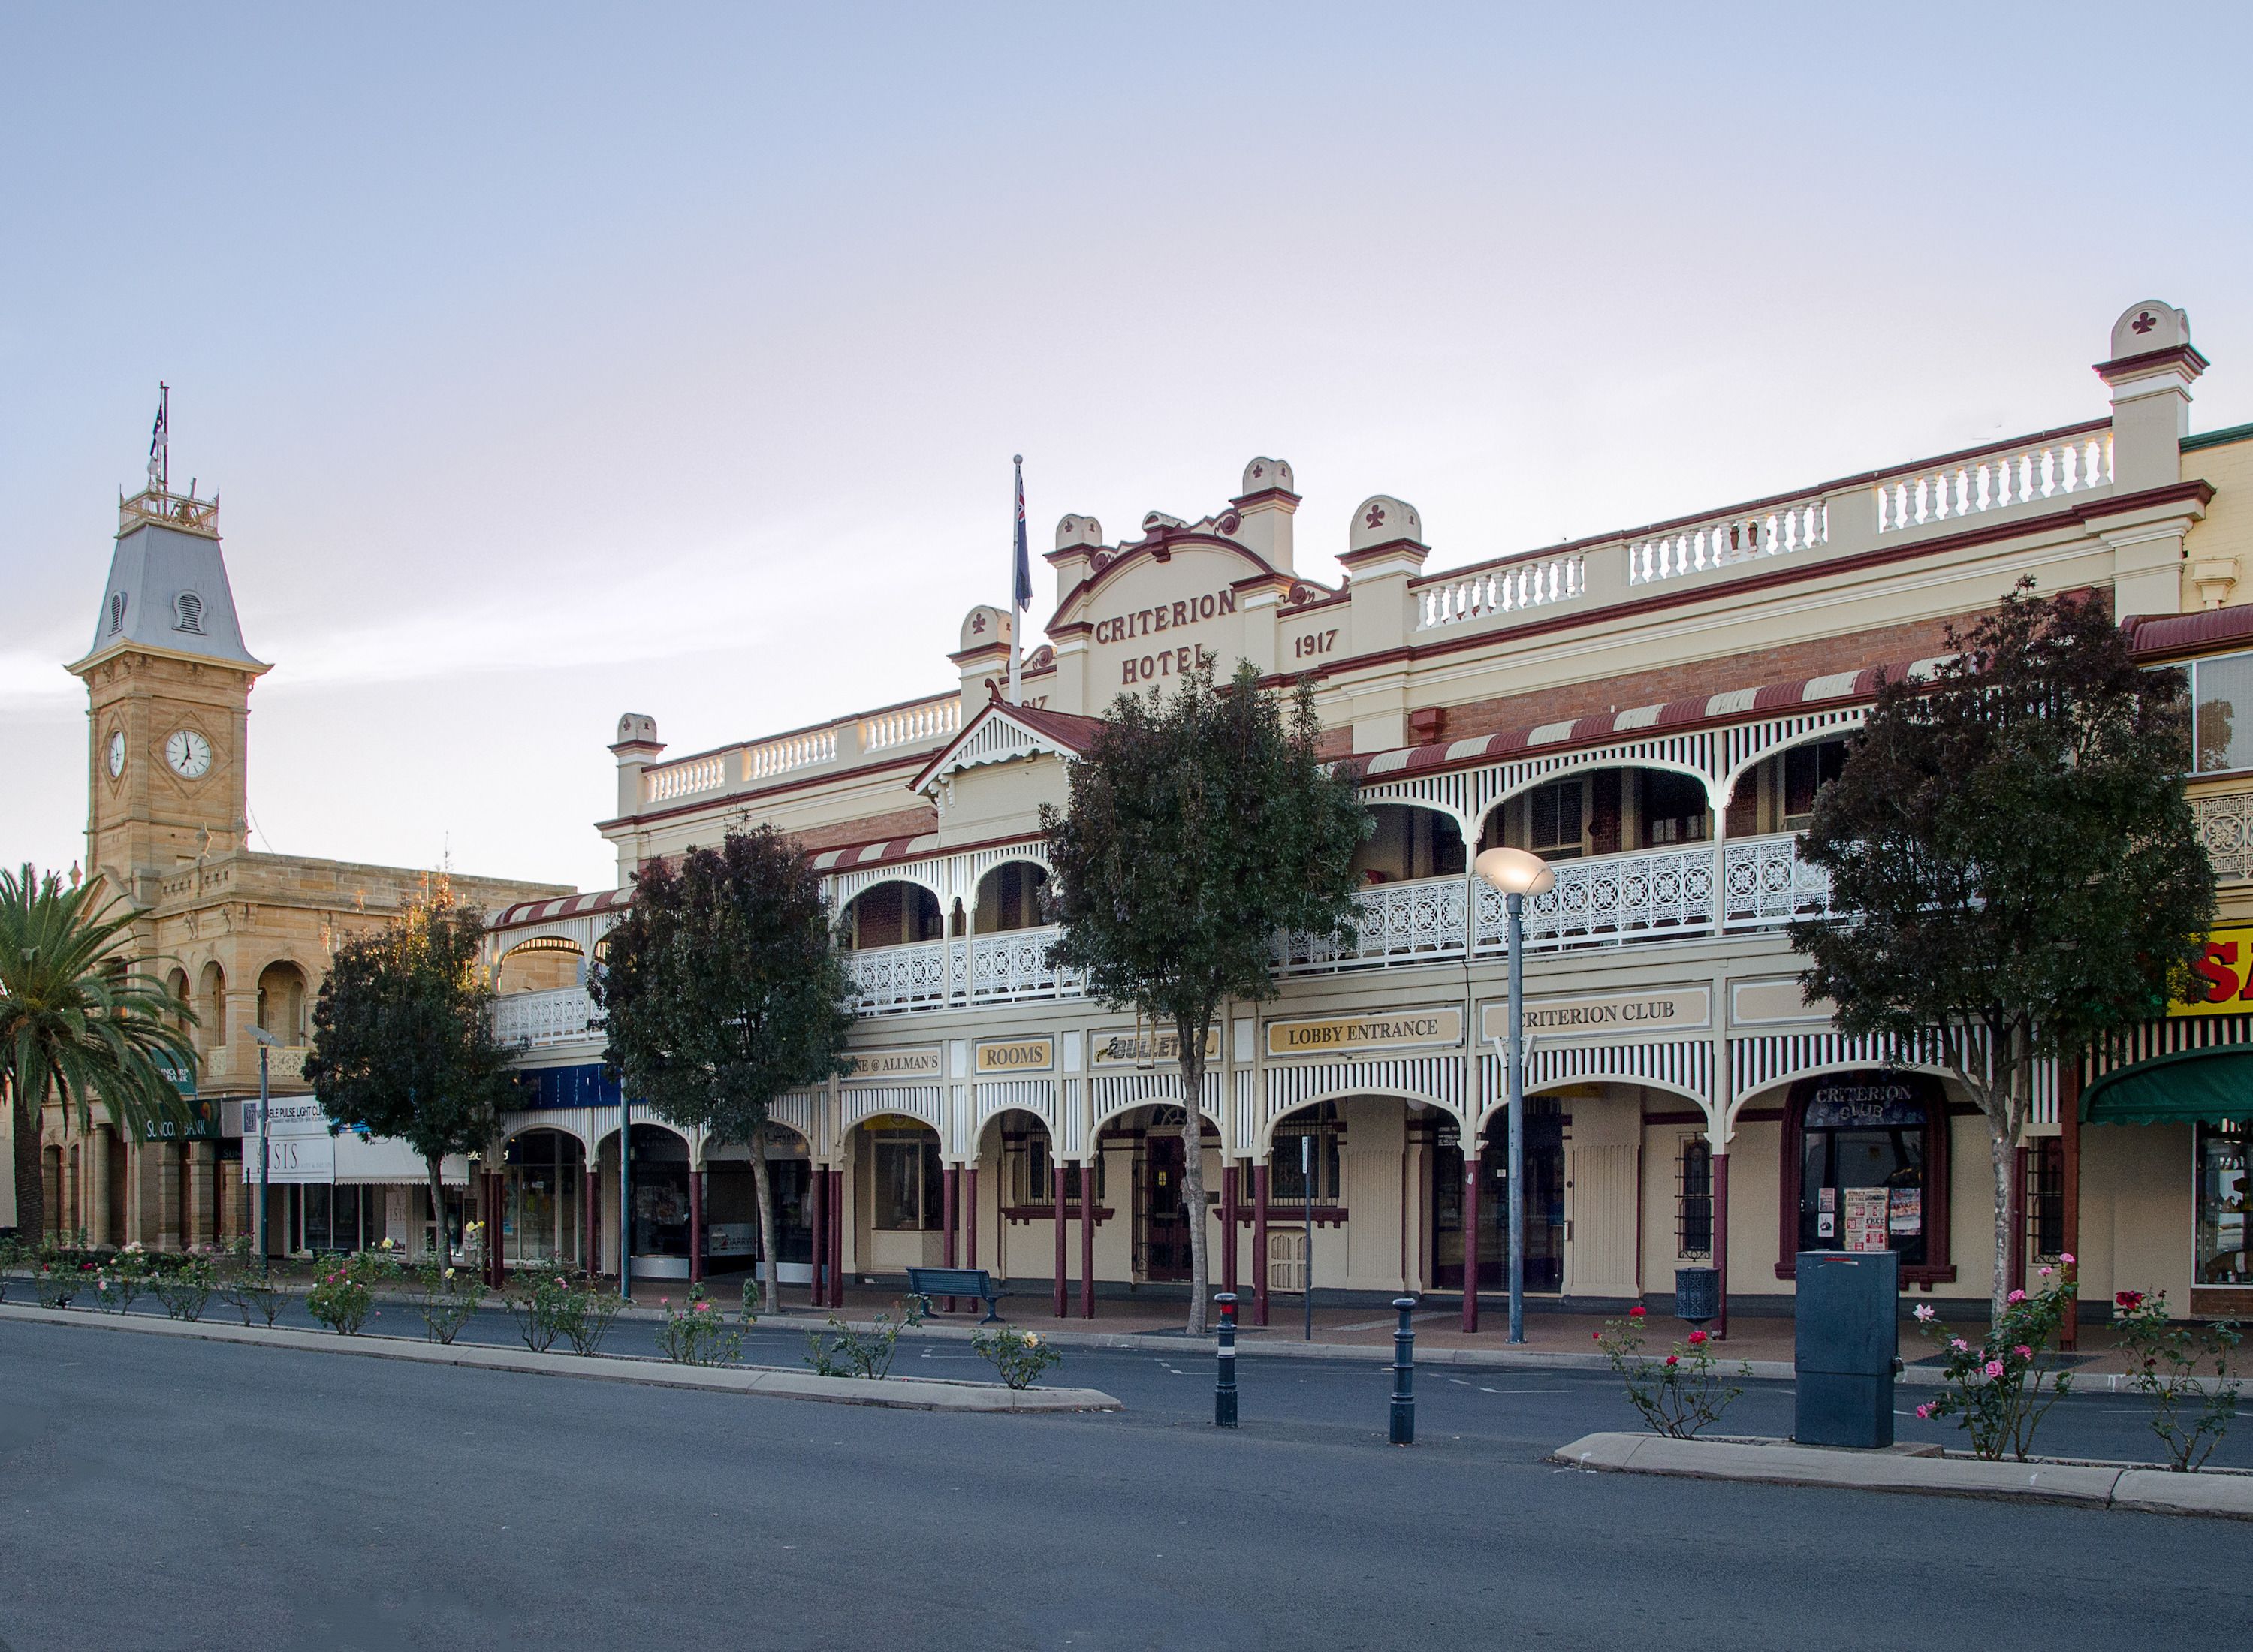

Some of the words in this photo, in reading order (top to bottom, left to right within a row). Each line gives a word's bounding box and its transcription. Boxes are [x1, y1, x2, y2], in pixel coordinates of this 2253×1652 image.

[1096, 589, 1238, 644] CRITERION
[1295, 629, 1340, 659] 1917
[1121, 643, 1204, 685] HOTEL
[2188, 940, 2253, 1004] S
[1622, 1000, 1675, 1020] CLUB
[1289, 1025, 1343, 1045] LOBBY
[1347, 1018, 1438, 1041] ENTRANCE
[871, 1059, 880, 1072] @
[882, 1054, 938, 1071] ALLMAN'S
[985, 1045, 1043, 1066] ROOMS
[1816, 1084, 1912, 1103] CRITERION
[279, 1106, 296, 1118] PULSE
[297, 1105, 311, 1117] LIGHT
